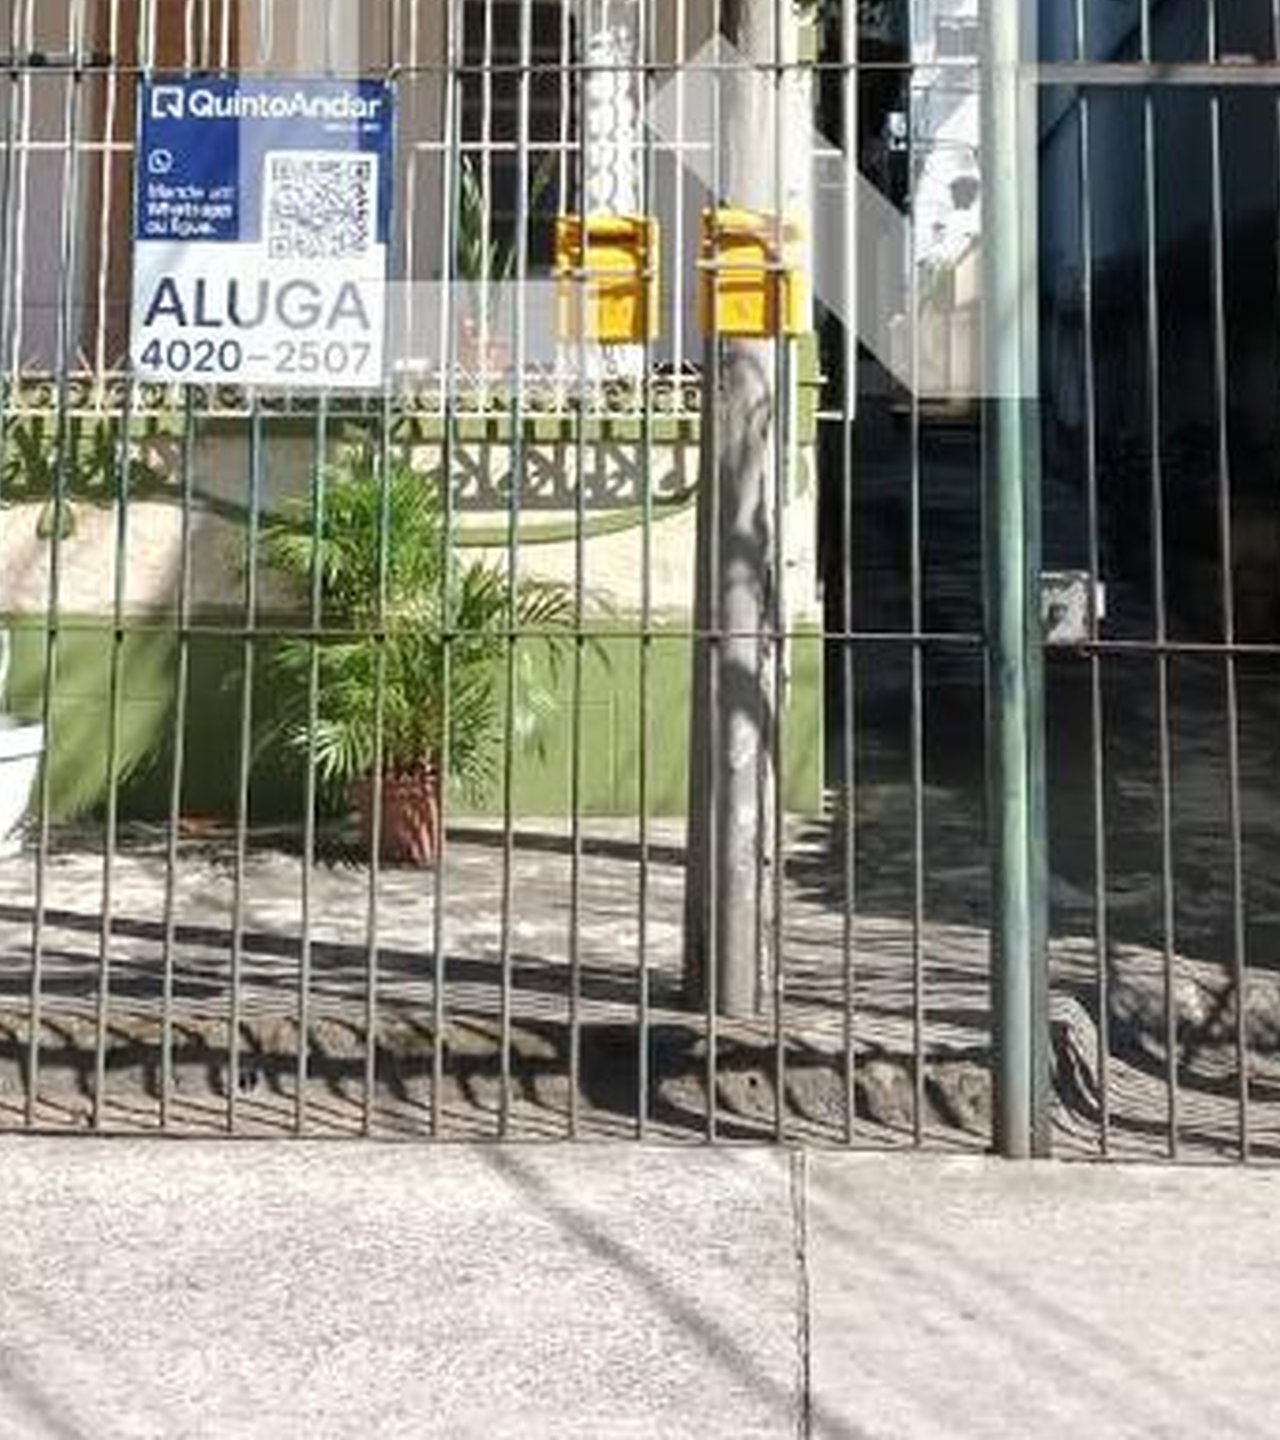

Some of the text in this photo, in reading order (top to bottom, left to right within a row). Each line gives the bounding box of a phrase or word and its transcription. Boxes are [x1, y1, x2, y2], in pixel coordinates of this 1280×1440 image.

[188, 89, 382, 120] QuintoAndar
[147, 182, 205, 199] Mande
[144, 220, 167, 234] ou
[143, 276, 372, 331] ALUGA
[139, 338, 372, 374] 4020-2507
